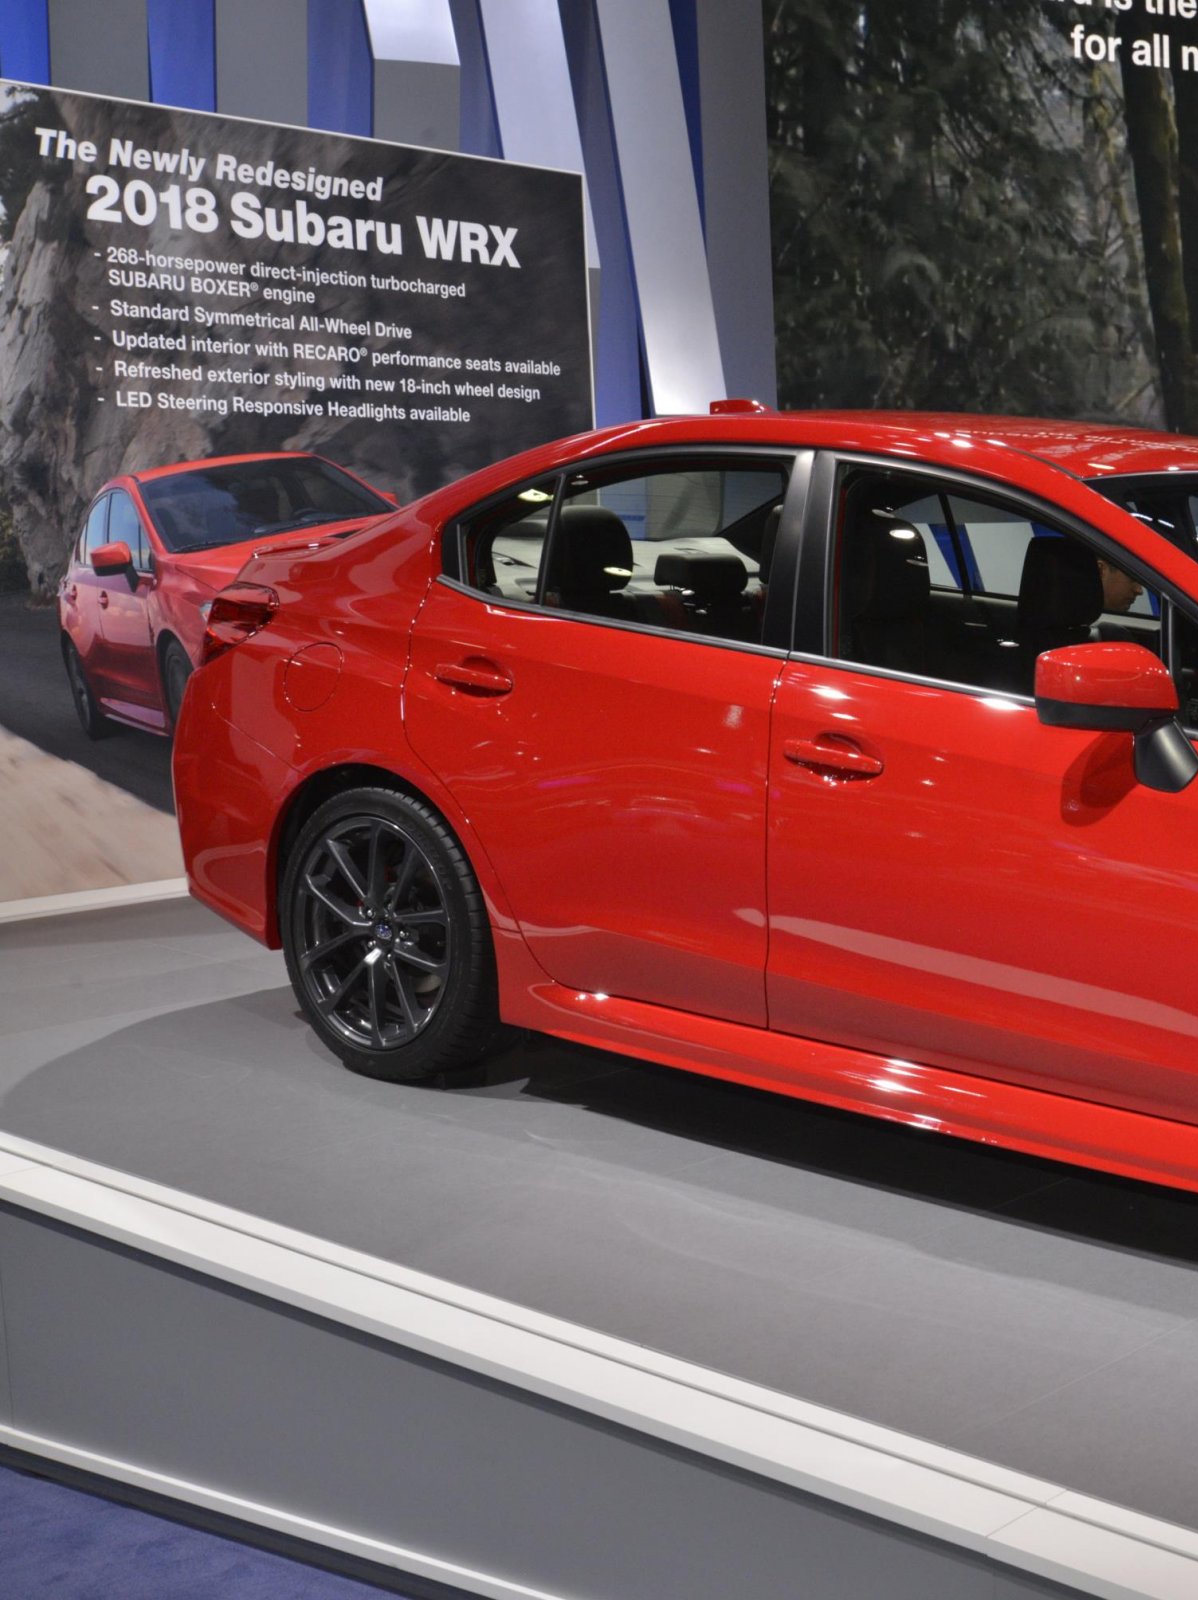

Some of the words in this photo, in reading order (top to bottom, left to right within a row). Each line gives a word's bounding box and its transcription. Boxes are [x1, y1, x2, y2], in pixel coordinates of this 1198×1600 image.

[1071, 25, 1121, 62] for
[1132, 33, 1170, 68] all
[34, 127, 97, 162] The
[109, 138, 205, 182] Newly
[216, 153, 384, 201] Redesigned
[86, 175, 220, 233] 2018
[230, 192, 403, 255] Subaru
[416, 216, 521, 269] WRX
[107, 247, 246, 275] 268-horsepower
[250, 262, 367, 288] direct-injection
[371, 274, 466, 298] turbocharged
[109, 269, 185, 291] SUBARU
[263, 287, 315, 305] engine
[110, 299, 189, 321] Standard
[194, 306, 295, 330] Symmetrical
[299, 315, 370, 336] All-Wheel
[375, 321, 412, 339] Drive
[112, 330, 186, 350] Updated
[191, 336, 250, 355] interior
[255, 342, 289, 358] with
[372, 350, 461, 369] performance
[466, 357, 501, 372] seats
[505, 360, 561, 376] available
[114, 360, 202, 381] Refreshed
[207, 369, 270, 385] exterior
[274, 372, 325, 391] styling
[329, 374, 361, 390] with
[365, 378, 395, 392] new
[400, 378, 450, 396] 18-inch
[454, 382, 494, 397] wheel
[497, 384, 541, 402] design
[116, 391, 152, 408] LED
[157, 393, 228, 415] Steering
[233, 396, 323, 416] Responsive
[328, 401, 406, 421] Headlights
[410, 406, 470, 422] available
